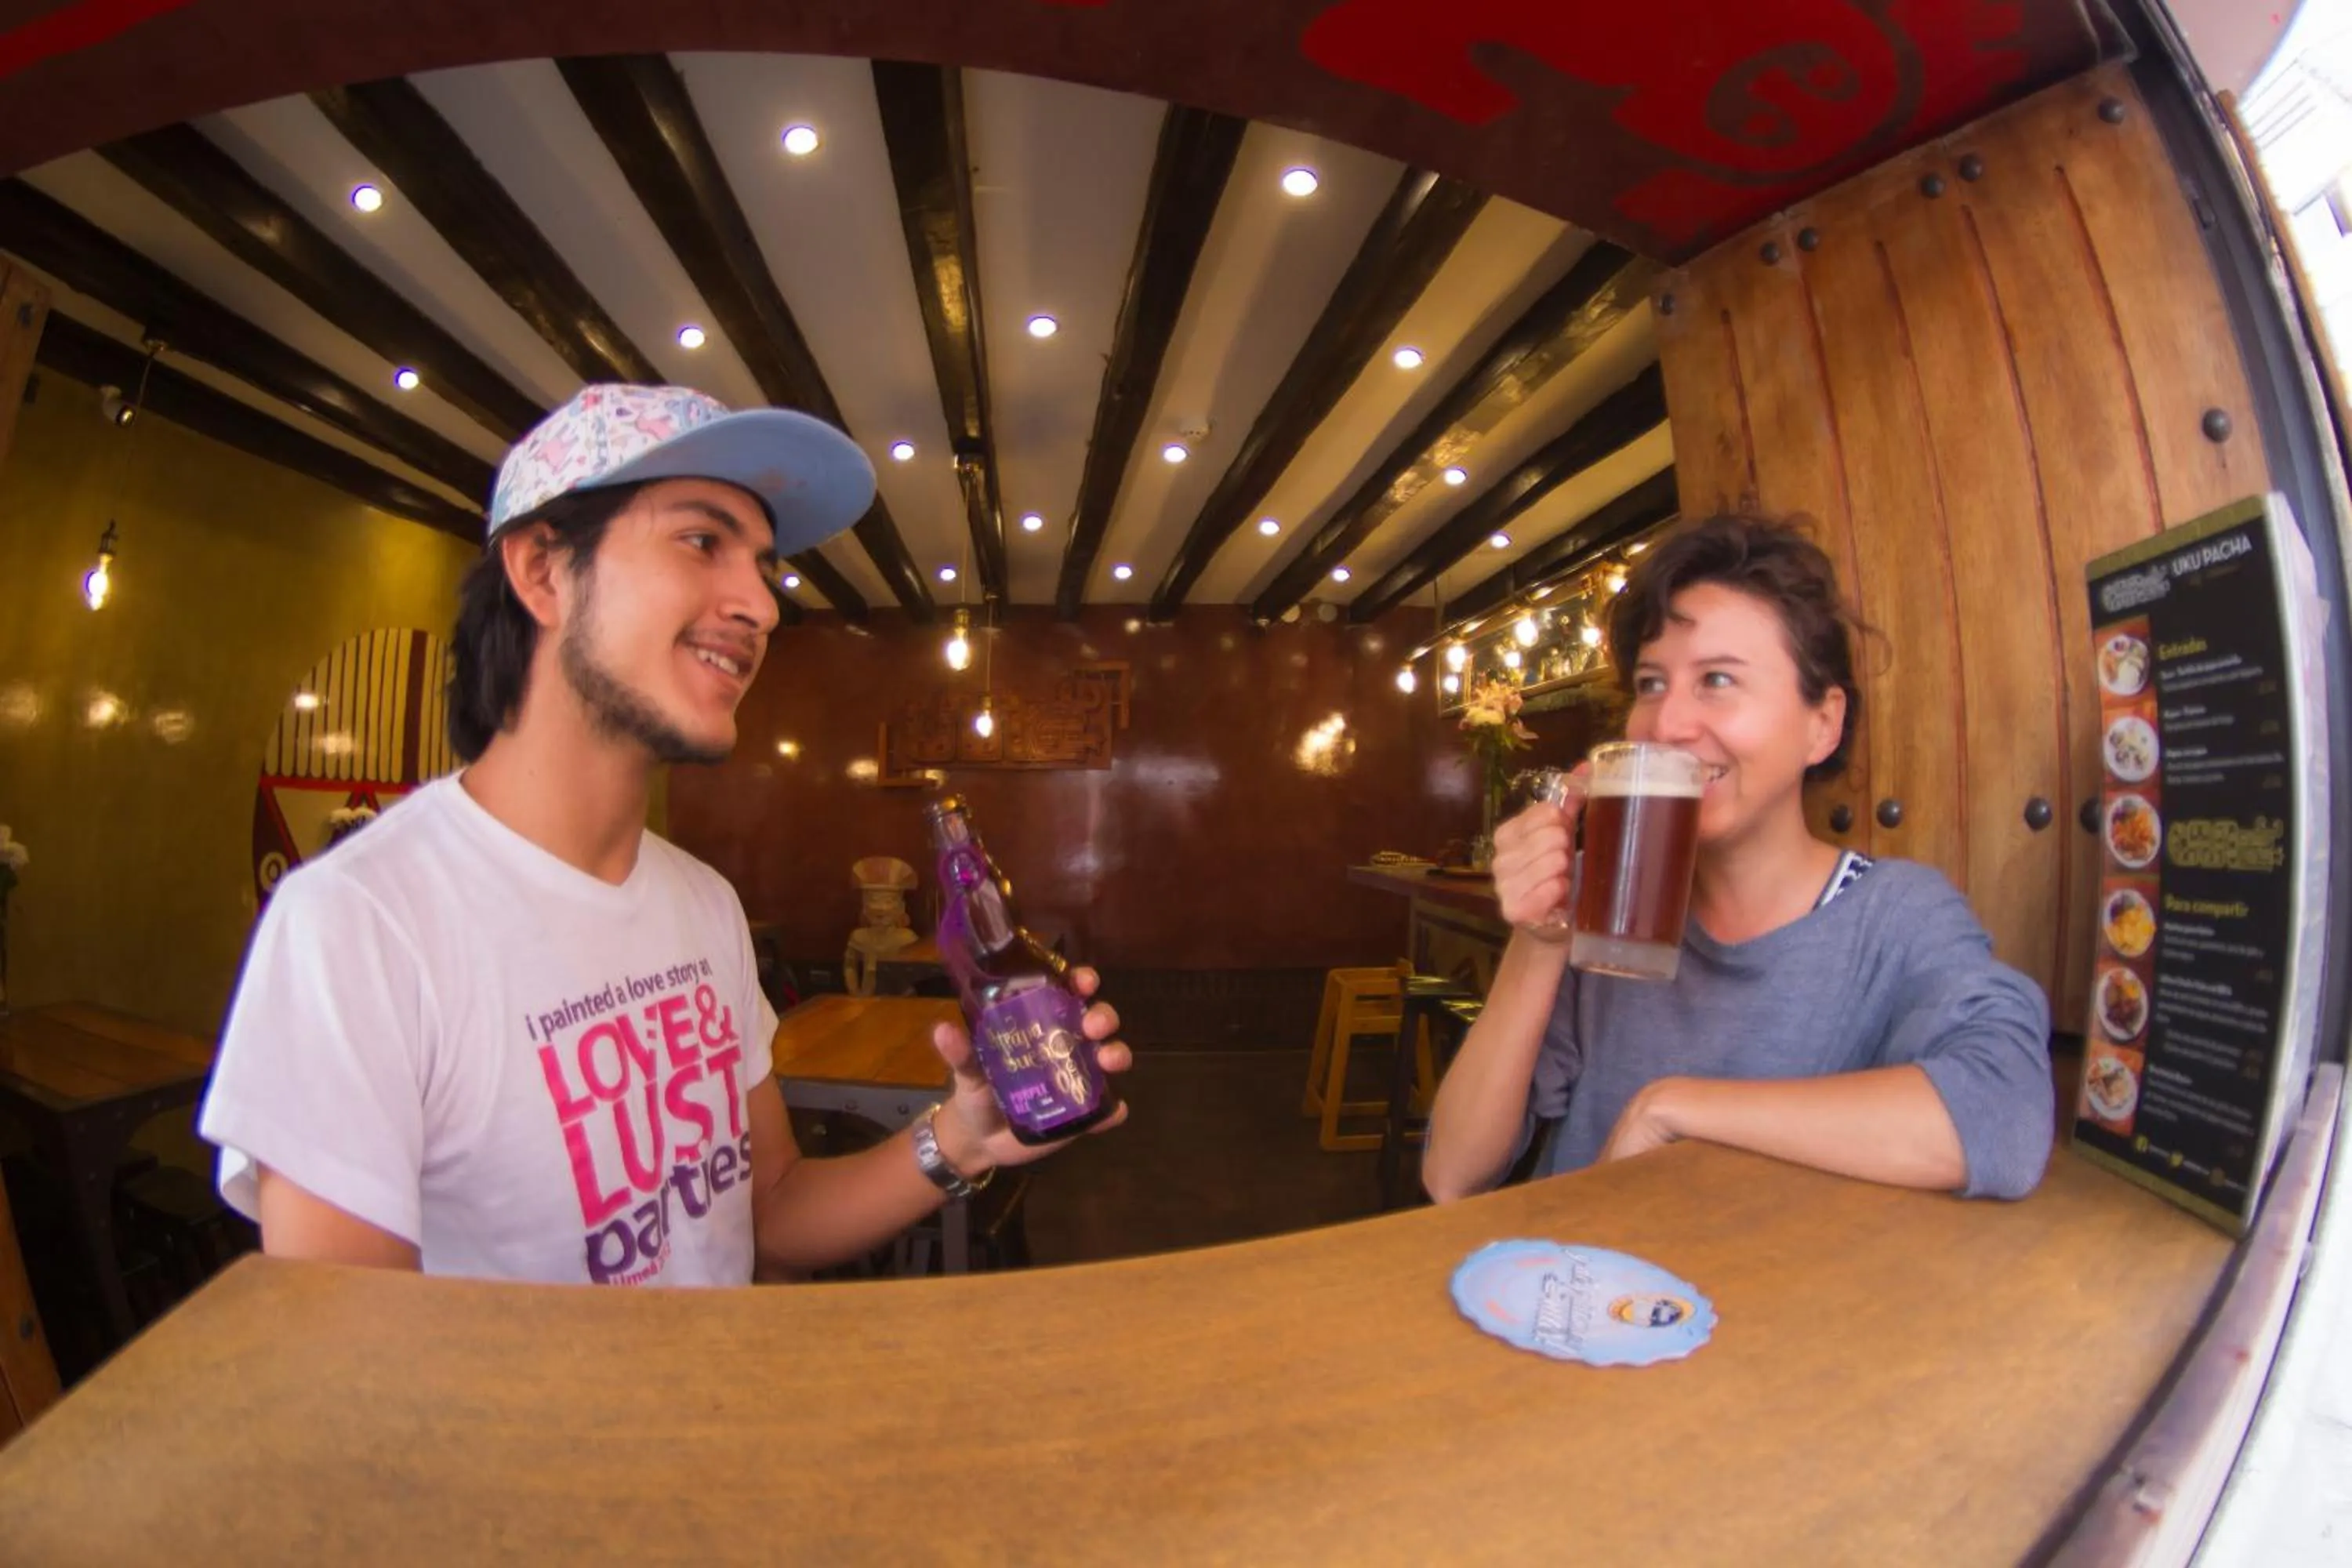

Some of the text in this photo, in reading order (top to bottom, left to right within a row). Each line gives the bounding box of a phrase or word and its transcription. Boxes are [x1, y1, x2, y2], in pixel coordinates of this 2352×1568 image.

[2172, 550, 2201, 576] UKU
[2202, 534, 2253, 564] PACHA
[537, 983, 740, 1125] LOVE &
[538, 982, 615, 1043] painted
[615, 985, 628, 1005] a
[625, 975, 666, 1002] love
[666, 959, 700, 988] story
[562, 1044, 742, 1228] LUST
